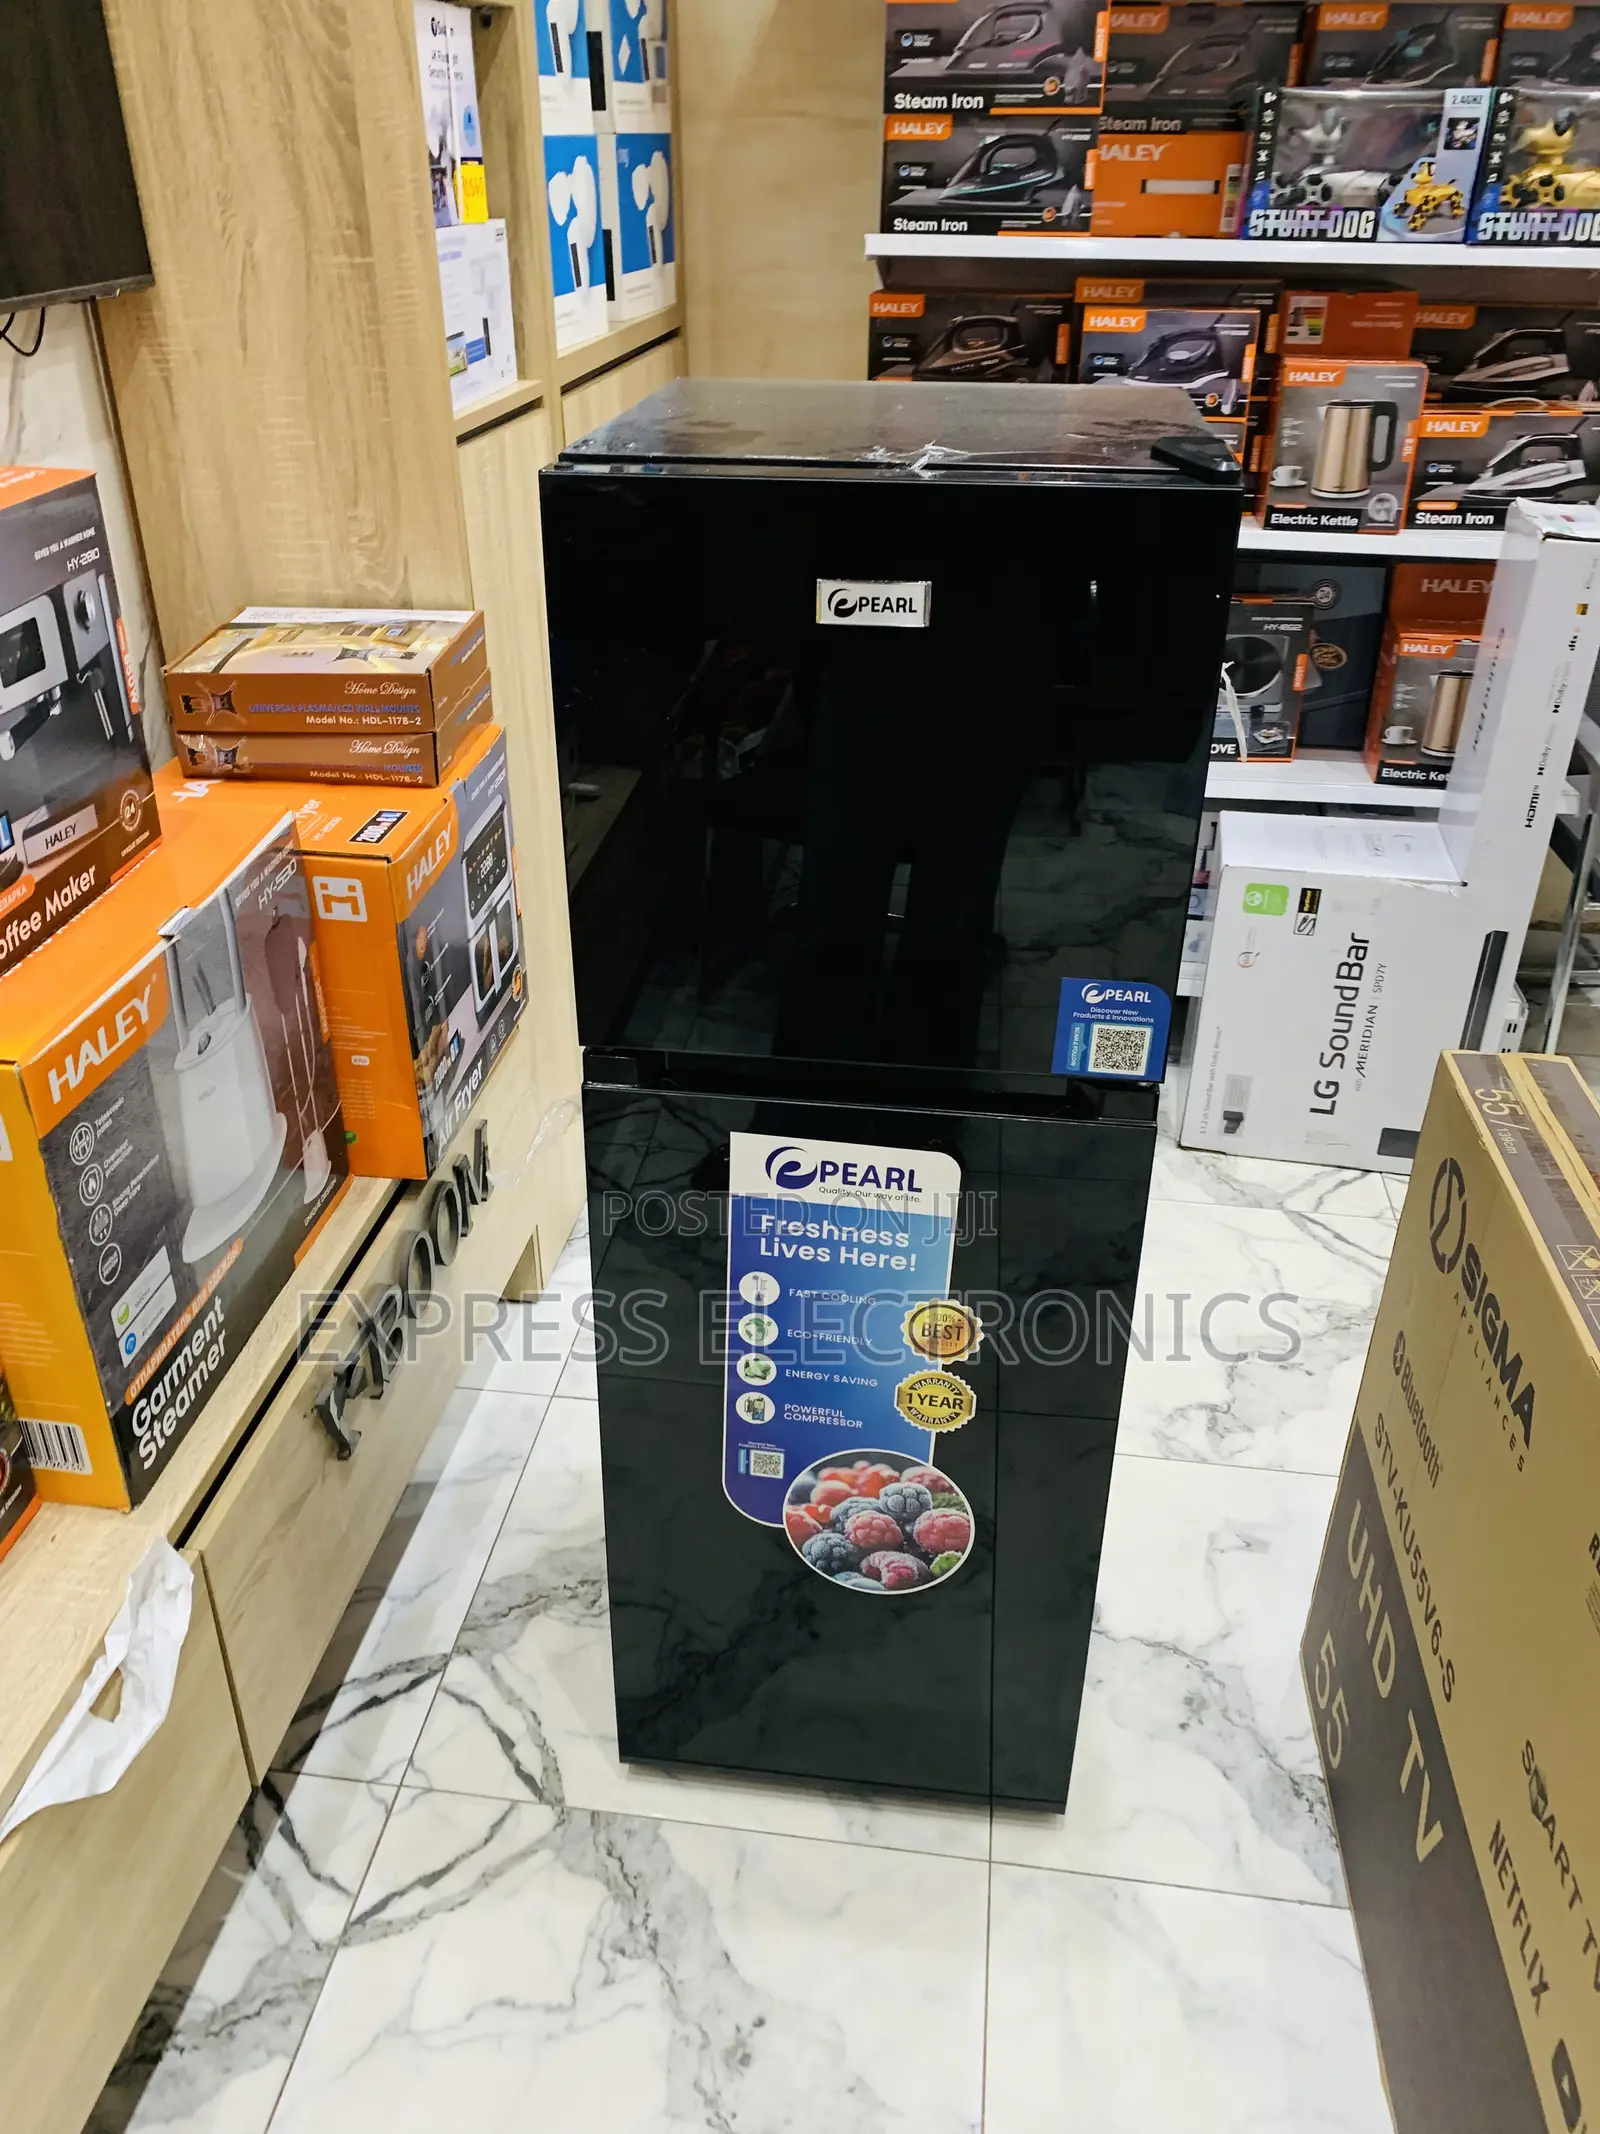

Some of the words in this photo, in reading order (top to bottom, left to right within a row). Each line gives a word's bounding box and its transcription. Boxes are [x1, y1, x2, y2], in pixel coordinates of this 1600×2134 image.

[1323, 10, 1386, 25] HALEY
[1511, 9, 1569, 24] HALEY
[894, 93, 948, 110] Steam
[952, 93, 984, 109] Iron
[893, 121, 949, 135] HALEY
[1099, 116, 1147, 131] Steam
[1150, 117, 1182, 131] Iron
[893, 218, 938, 232] Steam
[941, 219, 968, 232] Iron
[1082, 285, 1139, 299] HALEY
[873, 301, 920, 314] HALEY
[1089, 315, 1144, 328] HALEY
[1414, 312, 1470, 325] HALEY
[1288, 370, 1341, 383] HALEY
[1426, 420, 1482, 433] HALEY
[1271, 513, 1318, 526] Electric
[1320, 514, 1359, 527] Kettle
[1414, 512, 1463, 526] Steam
[1466, 514, 1495, 526] Iron
[1421, 578, 1493, 593] HALEY
[858, 596, 918, 613] PEARL
[1403, 643, 1453, 655] HALEY
[344, 681, 378, 696] Home
[380, 681, 417, 699] Design
[249, 704, 295, 713] UNIVERSAL
[306, 715, 337, 725] Model
[362, 716, 422, 726] HDL-117B-2
[349, 740, 382, 755] Home
[383, 741, 421, 759] Design
[1209, 743, 1236, 754] OVE
[309, 770, 340, 779] Model
[365, 773, 424, 784] HDL-117B-2
[1381, 767, 1428, 781] Electric
[1429, 768, 1451, 782] Ket
[44, 822, 78, 850] HALEY
[407, 823, 453, 899] HALEY
[0, 910, 42, 961] offee
[45, 864, 96, 922] Maker
[1105, 989, 1152, 1003] PEARL
[1072, 1012, 1105, 1020] Products
[1112, 1014, 1154, 1023] Innovations
[1090, 1006, 1121, 1015] Discover
[1355, 1004, 1379, 1079] MERIDIAN
[1373, 963, 1388, 994] SPD7Y
[47, 983, 151, 1106] HALEY
[1309, 1079, 1340, 1116] LG
[1474, 1087, 1526, 1118] 55
[437, 1110, 454, 1157] Air
[453, 1057, 484, 1123] Fryer
[1496, 1125, 1518, 1155] 139cm
[819, 1160, 922, 1193] PEARL
[855, 1189, 872, 1199] Our
[873, 1193, 893, 1202] way
[895, 1193, 904, 1202] of
[760, 1214, 910, 1248] Freshness
[760, 1237, 831, 1263] Lives
[839, 1246, 917, 1273] Here!
[789, 1288, 818, 1299] FAST
[821, 1291, 877, 1306] COOLING
[932, 1312, 956, 1323] 100%
[787, 1329, 873, 1347] ECO-FRIENDLY
[921, 1323, 965, 1341] BEST
[1461, 1242, 1536, 1452] SIGMA
[130, 1295, 226, 1438] Garment
[785, 1368, 830, 1382] ENERGY
[833, 1373, 879, 1388] SAVING
[912, 1378, 961, 1396] WARRANTY
[1453, 1290, 1526, 1473] APPLIANCES
[138, 1329, 227, 1471] Steamer
[906, 1393, 913, 1404] 1
[916, 1394, 964, 1411] YEAR
[784, 1403, 846, 1418] POWERFUL
[909, 1407, 957, 1425] WARRANTY
[783, 1412, 863, 1429] COMPRESSOR
[1400, 1354, 1443, 1489] Bluetooth
[1374, 1412, 1456, 1703] STV-KU55V6-S
[1347, 1498, 1396, 1699] UHD
[1400, 1709, 1444, 1863] TV
[1315, 1630, 1349, 1769] 55
[1520, 1739, 1583, 1911] SART
[1489, 1819, 1551, 2016] NETFLIX
